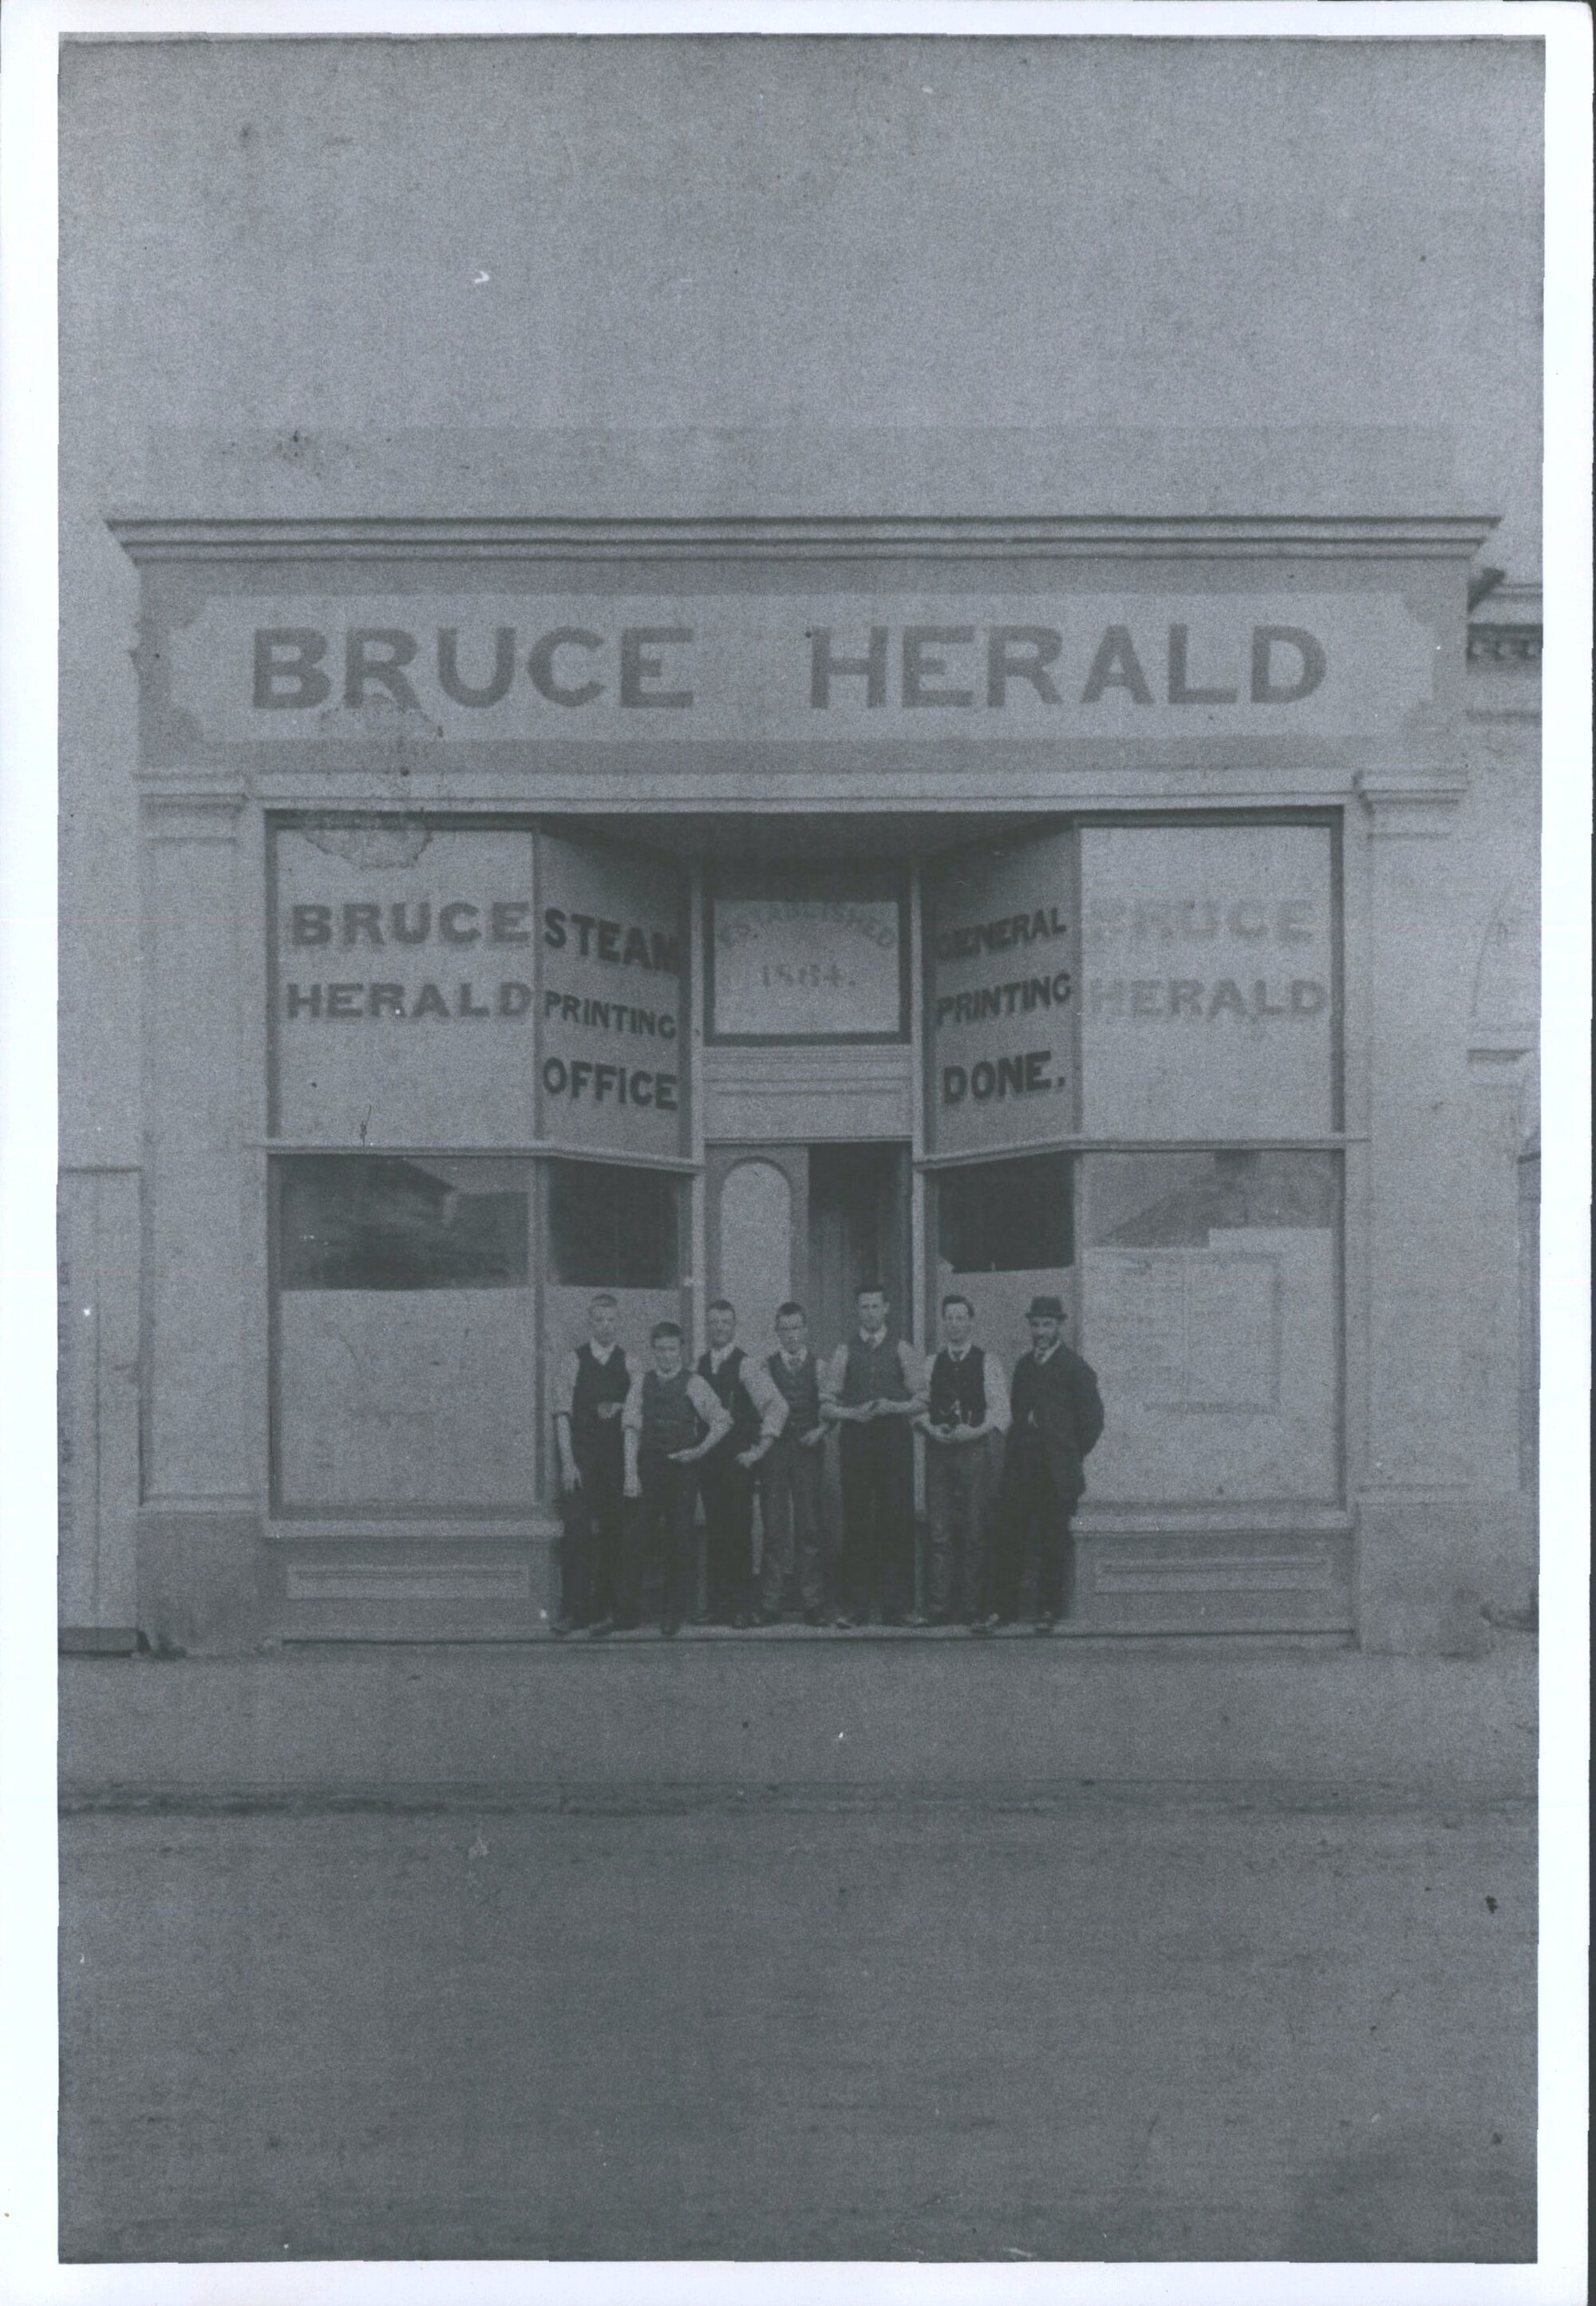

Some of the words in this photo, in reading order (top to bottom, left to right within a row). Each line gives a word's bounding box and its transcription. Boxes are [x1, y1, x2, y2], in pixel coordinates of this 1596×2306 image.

[252, 627, 694, 710] BRUCE
[808, 623, 1327, 709] HERALD
[290, 902, 530, 946] BRUCE
[286, 982, 532, 1019] HERALD
[544, 990, 677, 1040] PRINTING
[936, 971, 1072, 1026] PRINTING
[1088, 979, 1326, 1018] HERALD
[543, 1057, 678, 1111] OFFICE
